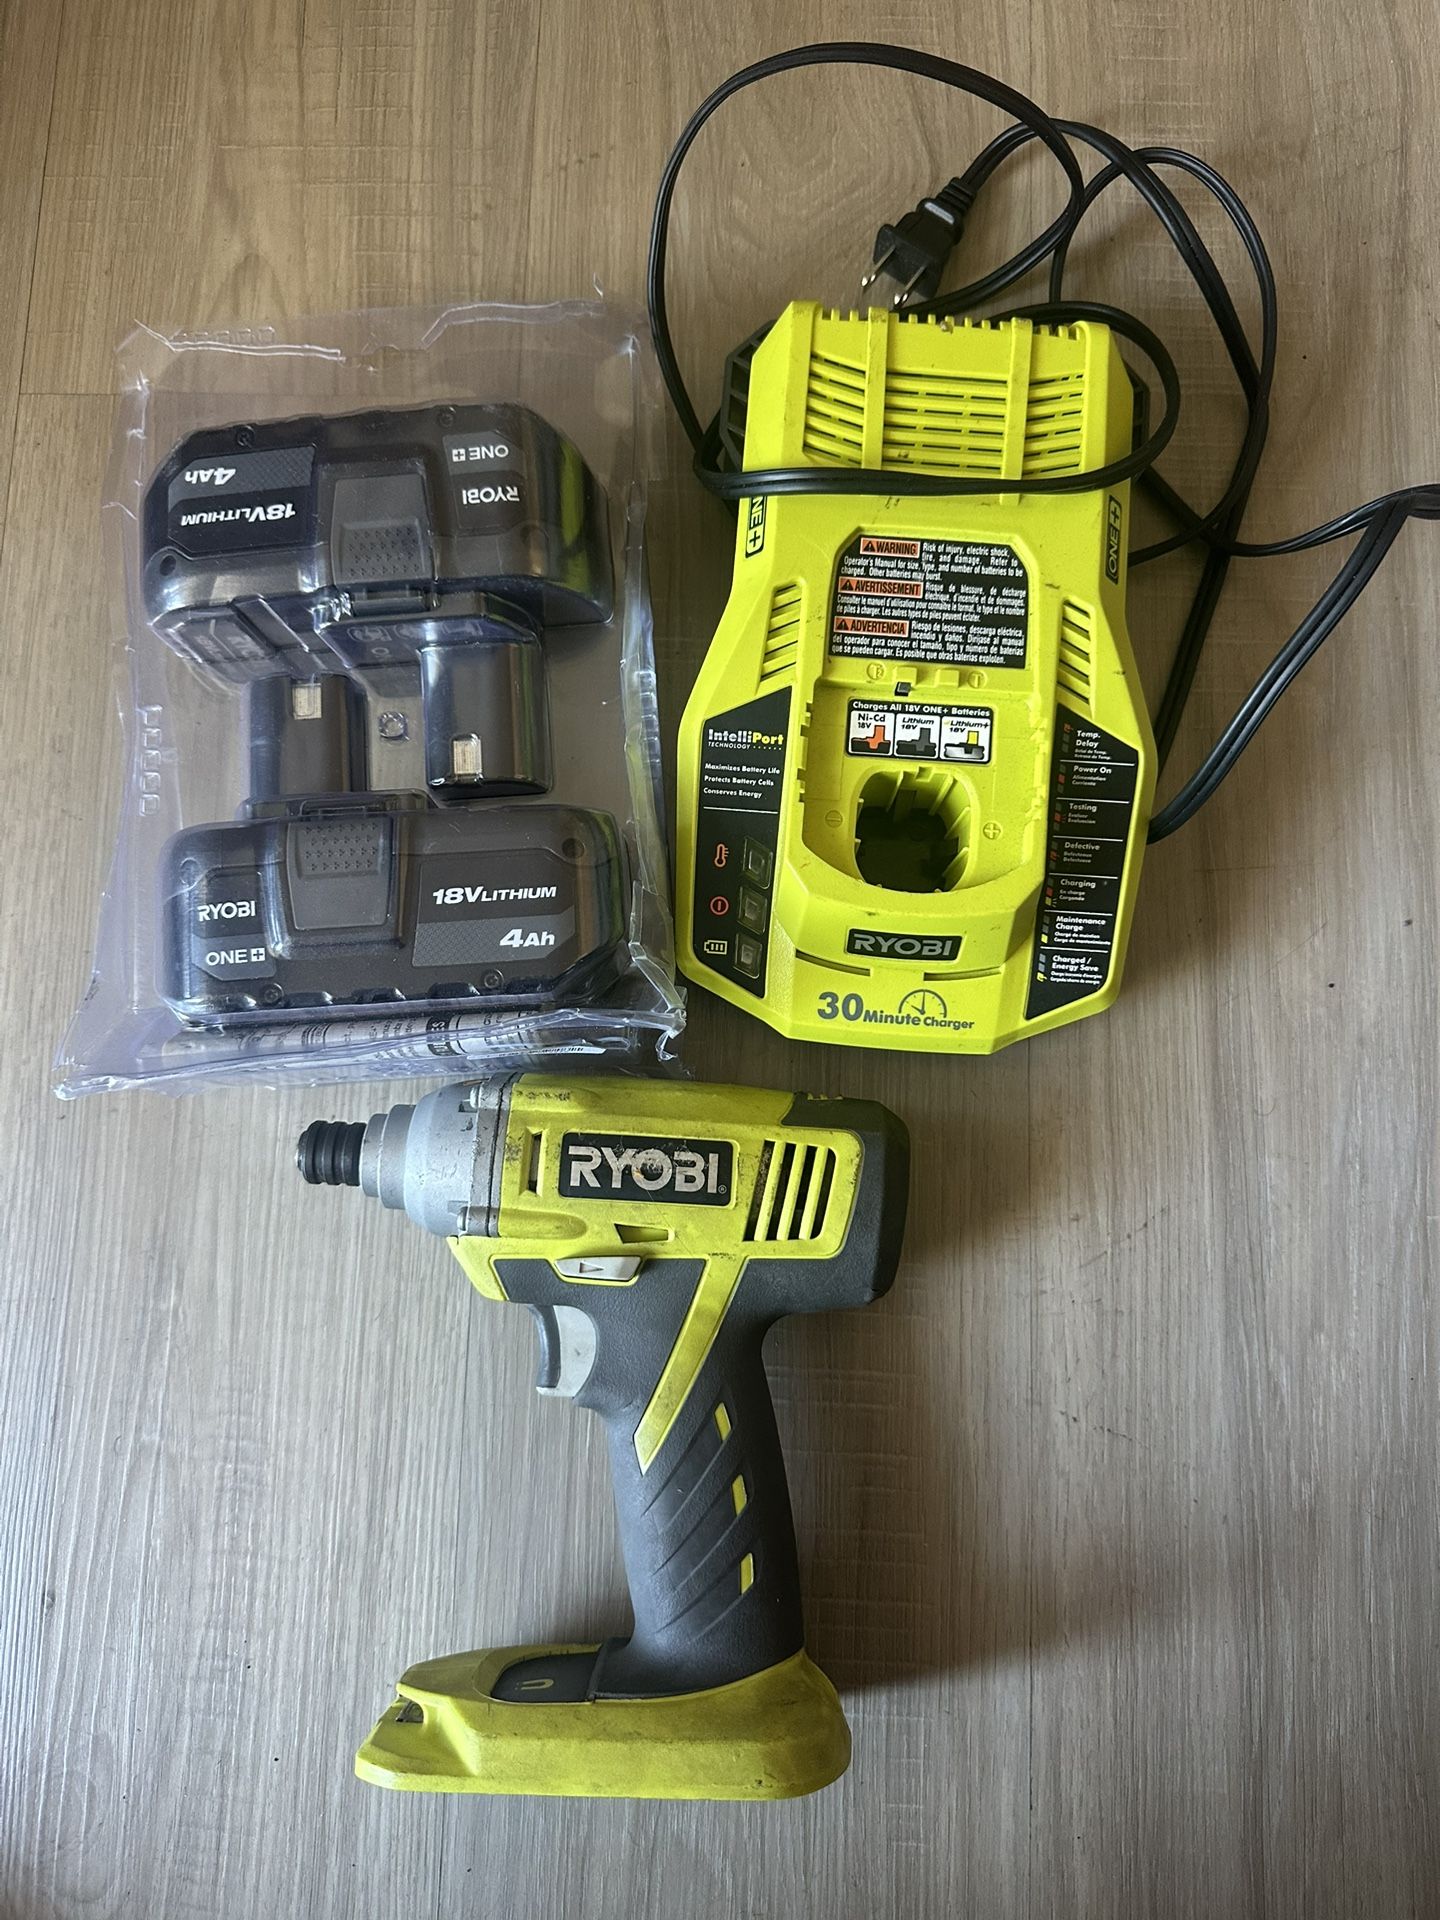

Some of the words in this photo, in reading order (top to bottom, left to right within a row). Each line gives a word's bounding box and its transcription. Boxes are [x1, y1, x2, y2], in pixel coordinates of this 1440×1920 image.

[185, 468, 236, 485] 4Ah
[462, 486, 520, 505] RYOBI
[877, 541, 917, 555] WARNING
[923, 543, 936, 551] Risk
[938, 544, 944, 552] of
[945, 545, 965, 556] injury,
[967, 546, 989, 555] electric
[991, 548, 1010, 559] shock,
[844, 556, 873, 567] Operator's
[875, 558, 897, 568] Manual
[898, 560, 906, 568] for
[939, 563, 950, 571] and
[951, 564, 973, 573] number
[974, 565, 981, 573] of
[982, 565, 1007, 575] batteries
[1009, 567, 1015, 575] to
[1016, 568, 1023, 576] be
[939, 554, 951, 562] and
[991, 557, 1008, 566] Refer
[1012, 558, 1018, 567] to
[870, 567, 885, 576] Other
[886, 568, 911, 578] batteries
[912, 573, 925, 581] may
[855, 580, 920, 596] AVERTISSEMENT
[926, 582, 943, 593] Risque
[949, 584, 955, 592] de
[991, 587, 997, 595] de
[851, 619, 905, 634] ADVERTENCIA
[912, 621, 932, 632] Riesgo
[933, 623, 941, 631] de
[970, 625, 997, 637] descarga
[833, 635, 843, 643] del
[844, 637, 871, 645] operador
[872, 639, 886, 647] para
[887, 640, 911, 648] conocer
[912, 640, 919, 648] el
[946, 642, 958, 652] tipo
[960, 645, 964, 653] y
[990, 645, 999, 653] de
[832, 646, 843, 654] que
[852, 646, 874, 655] pueden
[896, 648, 903, 656] Es
[904, 649, 926, 658] posible
[927, 652, 938, 660] que
[939, 651, 954, 660] otras
[852, 701, 888, 711] Charges
[890, 703, 902, 711] All
[904, 704, 920, 712] 18V
[922, 706, 948, 714] ONE+
[951, 707, 990, 716] Batteries
[858, 714, 886, 722] Ni-Cd
[902, 717, 934, 725] Lithium
[950, 720, 989, 728] Lithium+
[708, 729, 784, 744] IntelliPort
[1077, 730, 1100, 739] Temp.
[708, 742, 750, 750] TECHNOLOGY
[1076, 740, 1099, 748] Delay
[705, 763, 740, 772] Maximizes
[742, 766, 766, 774] Battery
[1074, 765, 1098, 773] Power
[1100, 766, 1112, 774] On
[704, 775, 730, 783] Protects
[732, 777, 756, 786] Battery
[704, 788, 737, 796] Conserves
[739, 790, 762, 799] Energy
[1069, 803, 1097, 812] Testing
[1064, 841, 1100, 850] Defective
[1060, 879, 1096, 888] Charging
[197, 900, 256, 922] RYOBI
[1056, 916, 1106, 925] Maintenance
[1056, 923, 1084, 932] Charge
[500, 928, 555, 948] 4Ah
[854, 934, 952, 956] RYOBI
[1052, 955, 1086, 964] Charged
[1052, 962, 1078, 971] Energy
[924, 1016, 974, 1030] Charger
